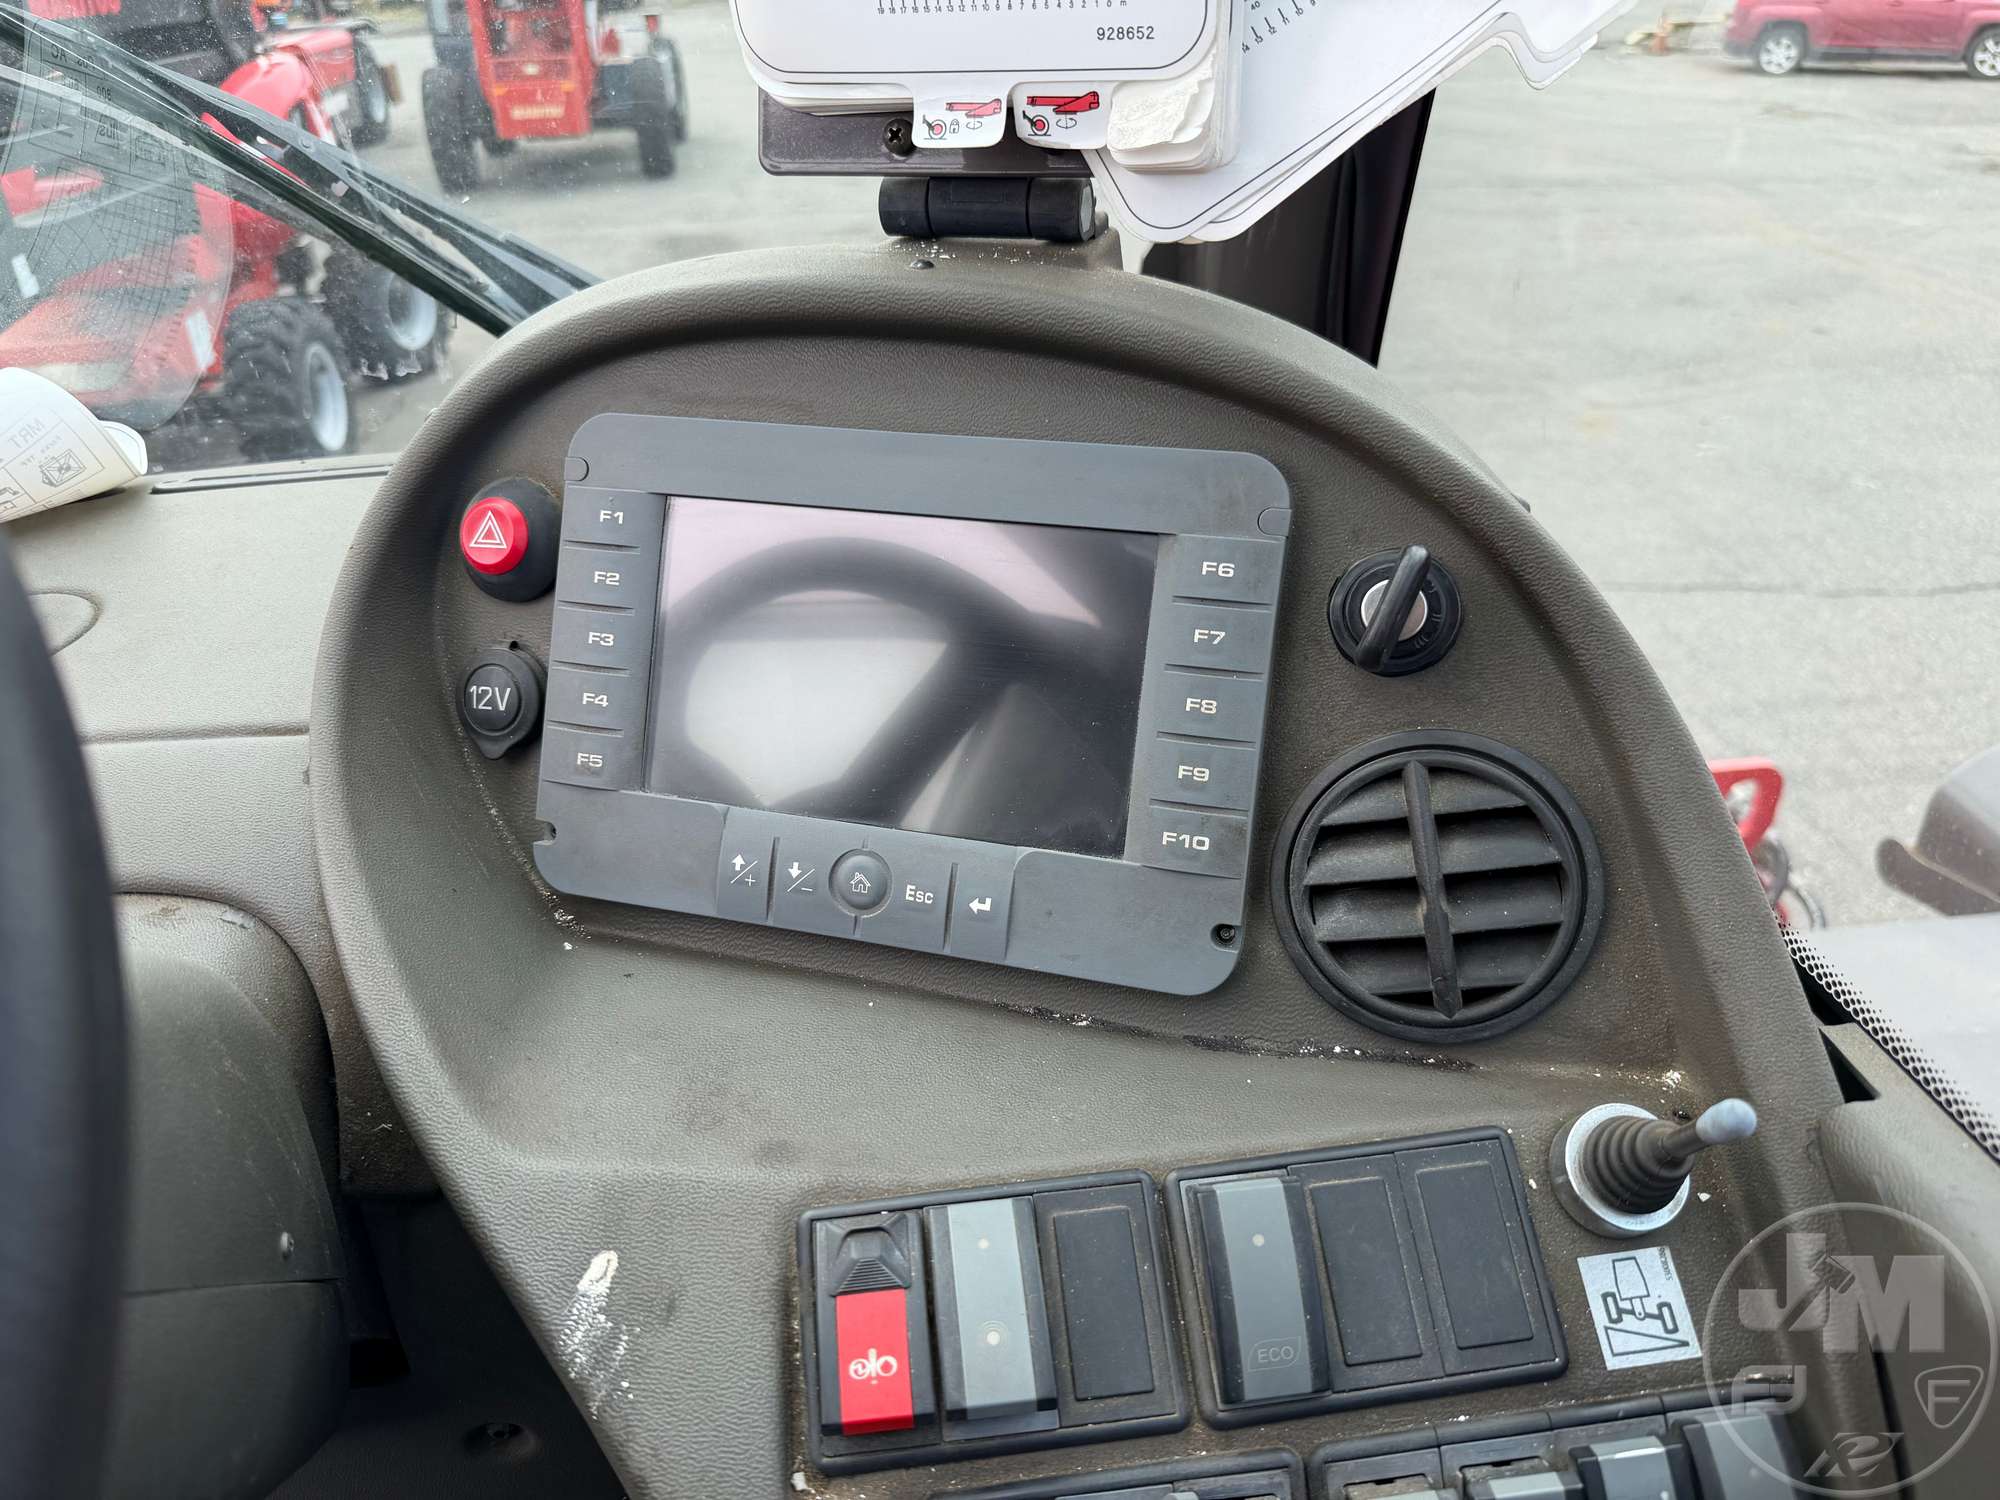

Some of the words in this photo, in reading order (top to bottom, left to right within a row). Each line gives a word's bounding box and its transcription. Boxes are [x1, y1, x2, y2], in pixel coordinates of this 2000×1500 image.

[1250, 1, 1260, 10] 40
[1295, 8, 1304, 16] 10
[1096, 26, 1155, 41] 928652
[599, 511, 624, 524] F1
[1201, 561, 1236, 578] F6
[593, 572, 620, 586] F2
[588, 632, 614, 646] F3
[1193, 629, 1226, 645] F7
[469, 686, 511, 711] 12V
[582, 692, 608, 707] F4
[1185, 698, 1217, 714] F8
[576, 753, 603, 766] F5
[1177, 765, 1210, 782] F9
[1162, 831, 1210, 850] F10
[905, 885, 934, 904] Esc
[1258, 1346, 1294, 1363] ECO
